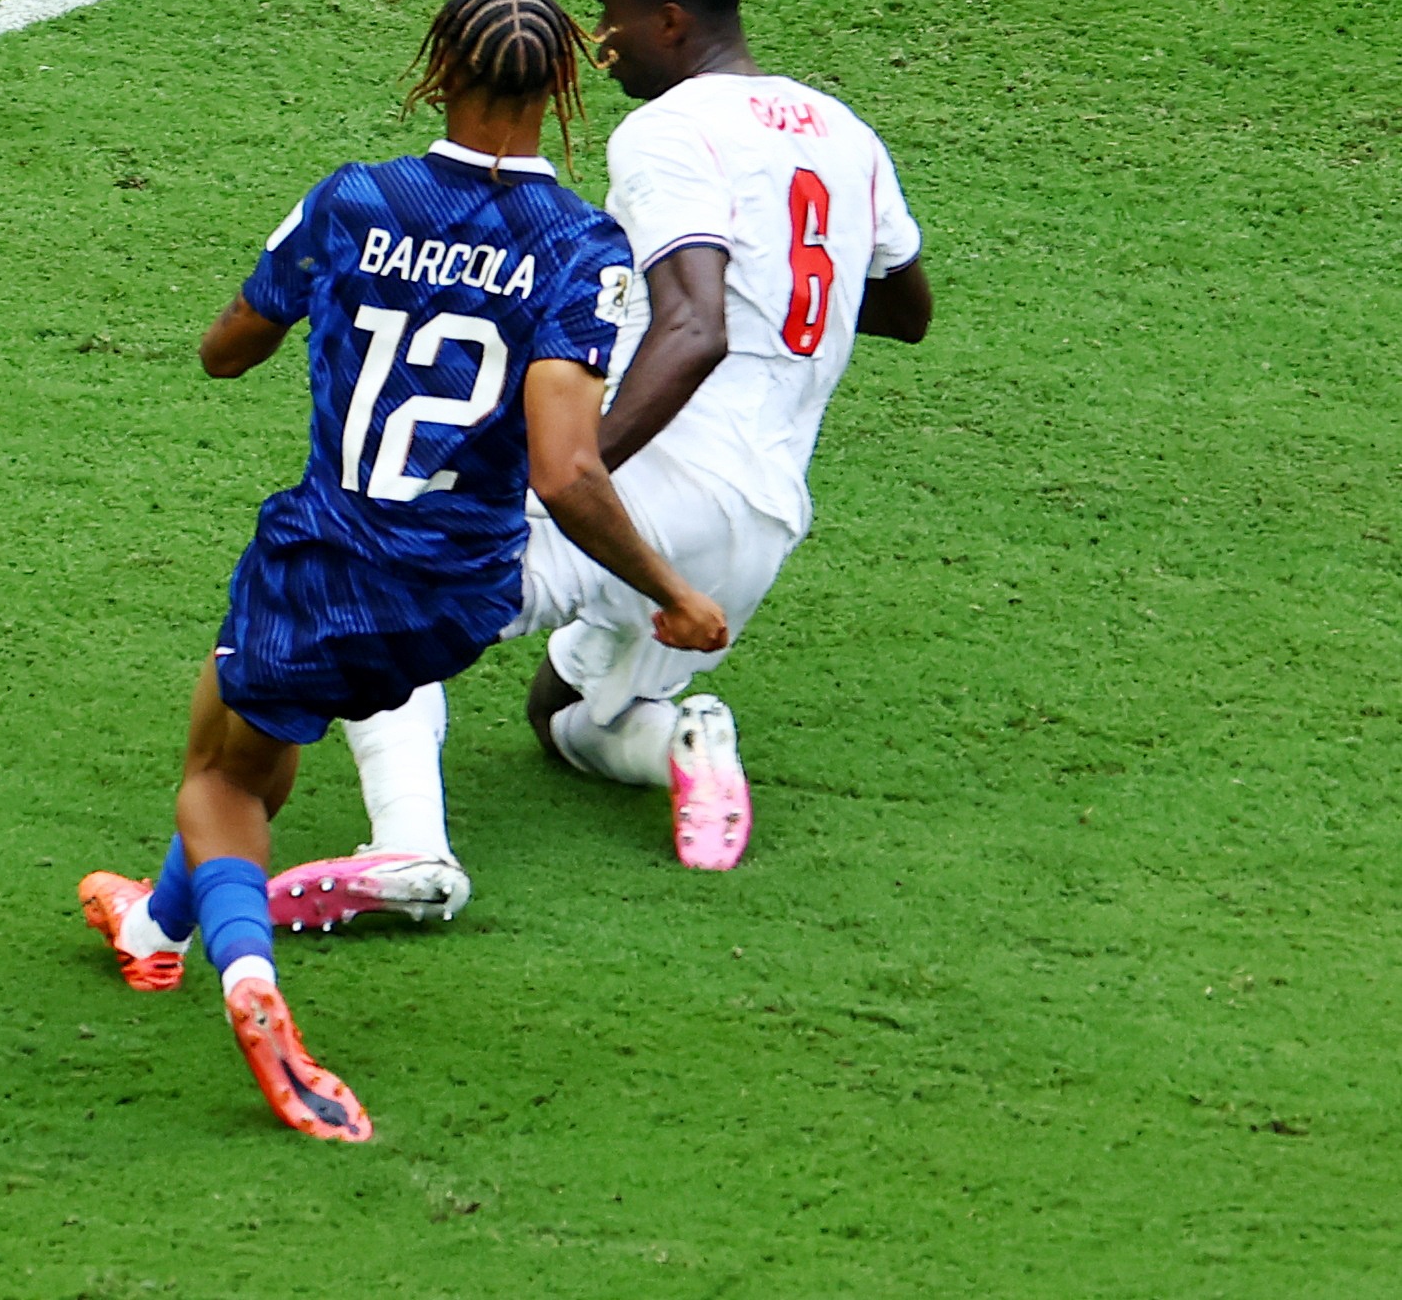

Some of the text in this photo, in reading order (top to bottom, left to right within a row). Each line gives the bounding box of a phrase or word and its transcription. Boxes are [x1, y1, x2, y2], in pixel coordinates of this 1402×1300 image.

[359, 227, 536, 300] BARCOLA
[782, 167, 834, 356] 6
[341, 304, 509, 502] 12
